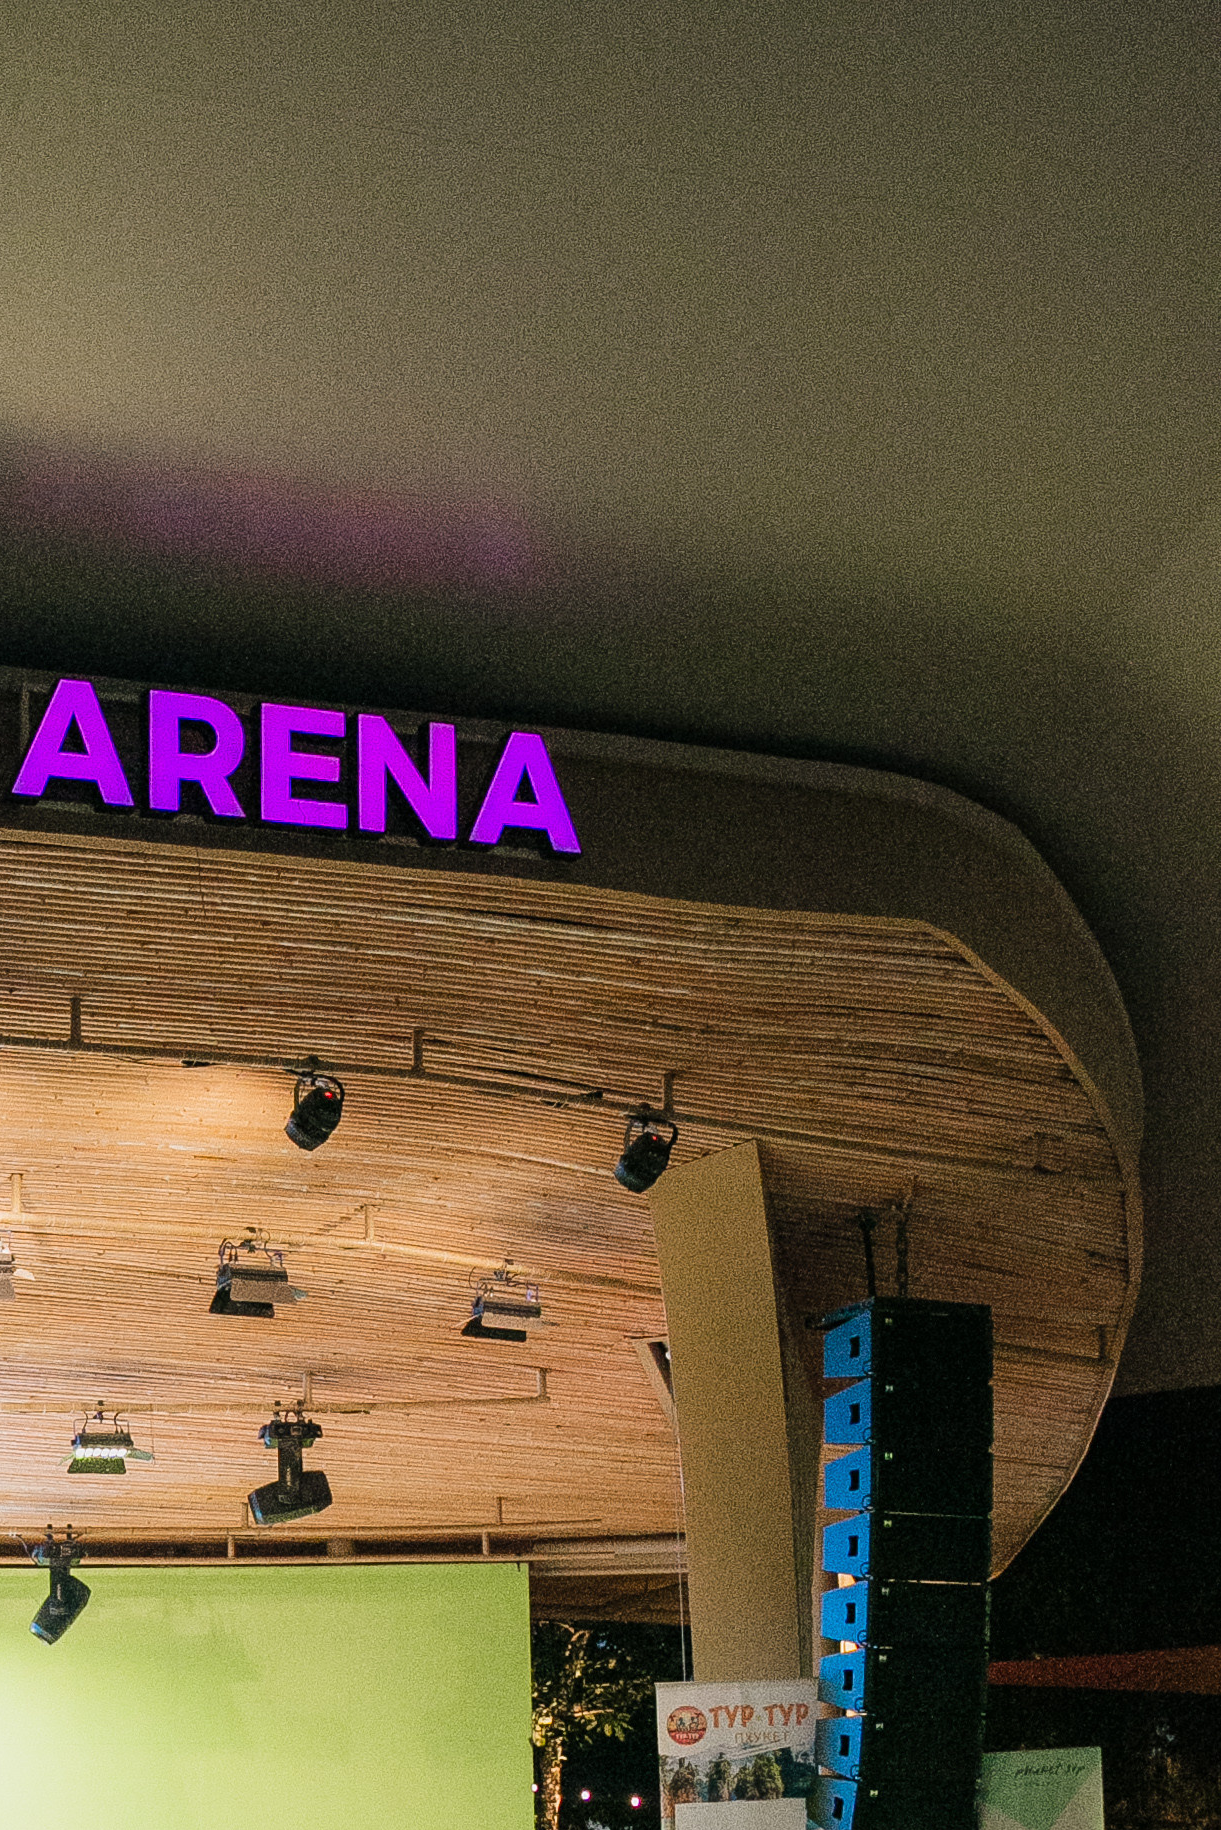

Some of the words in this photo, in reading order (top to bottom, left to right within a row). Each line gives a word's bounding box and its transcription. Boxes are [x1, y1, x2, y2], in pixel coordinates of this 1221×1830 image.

[12, 678, 581, 854] ARENA
[709, 1705, 754, 1728] ТУР
[763, 1703, 809, 1726] ТУР
[735, 1730, 790, 1744] ПХУКЕТ
